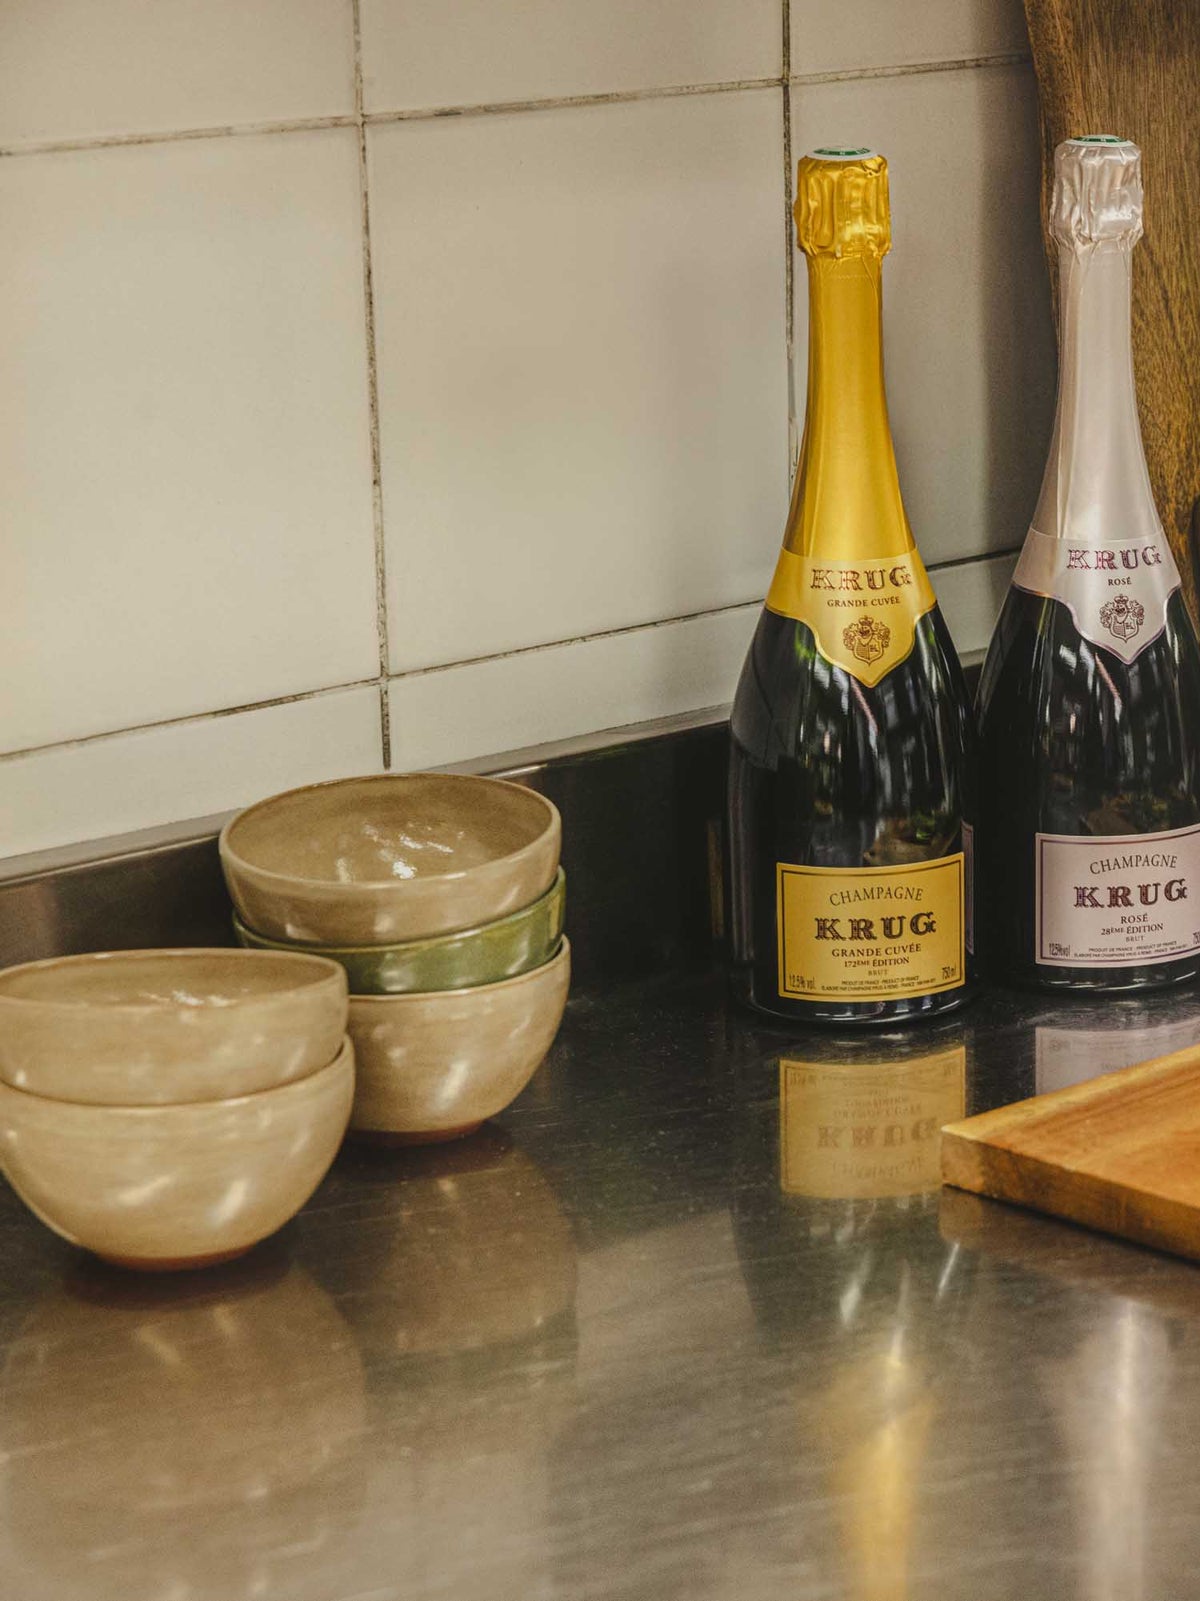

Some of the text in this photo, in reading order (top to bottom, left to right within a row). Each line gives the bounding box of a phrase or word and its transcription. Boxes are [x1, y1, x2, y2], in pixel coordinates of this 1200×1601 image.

[1066, 544, 1162, 570] KRUG
[810, 565, 912, 591] KRUG
[1108, 576, 1132, 586] ROSÉ
[827, 596, 901, 607] GRANDE CUVÉE
[1089, 854, 1178, 874] CHAMPAGNE
[829, 886, 923, 906] CHAMPAGNE
[1073, 878, 1188, 908] KRUG
[814, 911, 937, 941] KRUG
[1120, 913, 1148, 924] ROSÉ
[1126, 923, 1163, 934] ÉDITION
[832, 943, 921, 957] GRANDE CUVÉE
[872, 957, 909, 967] ÉDITION
